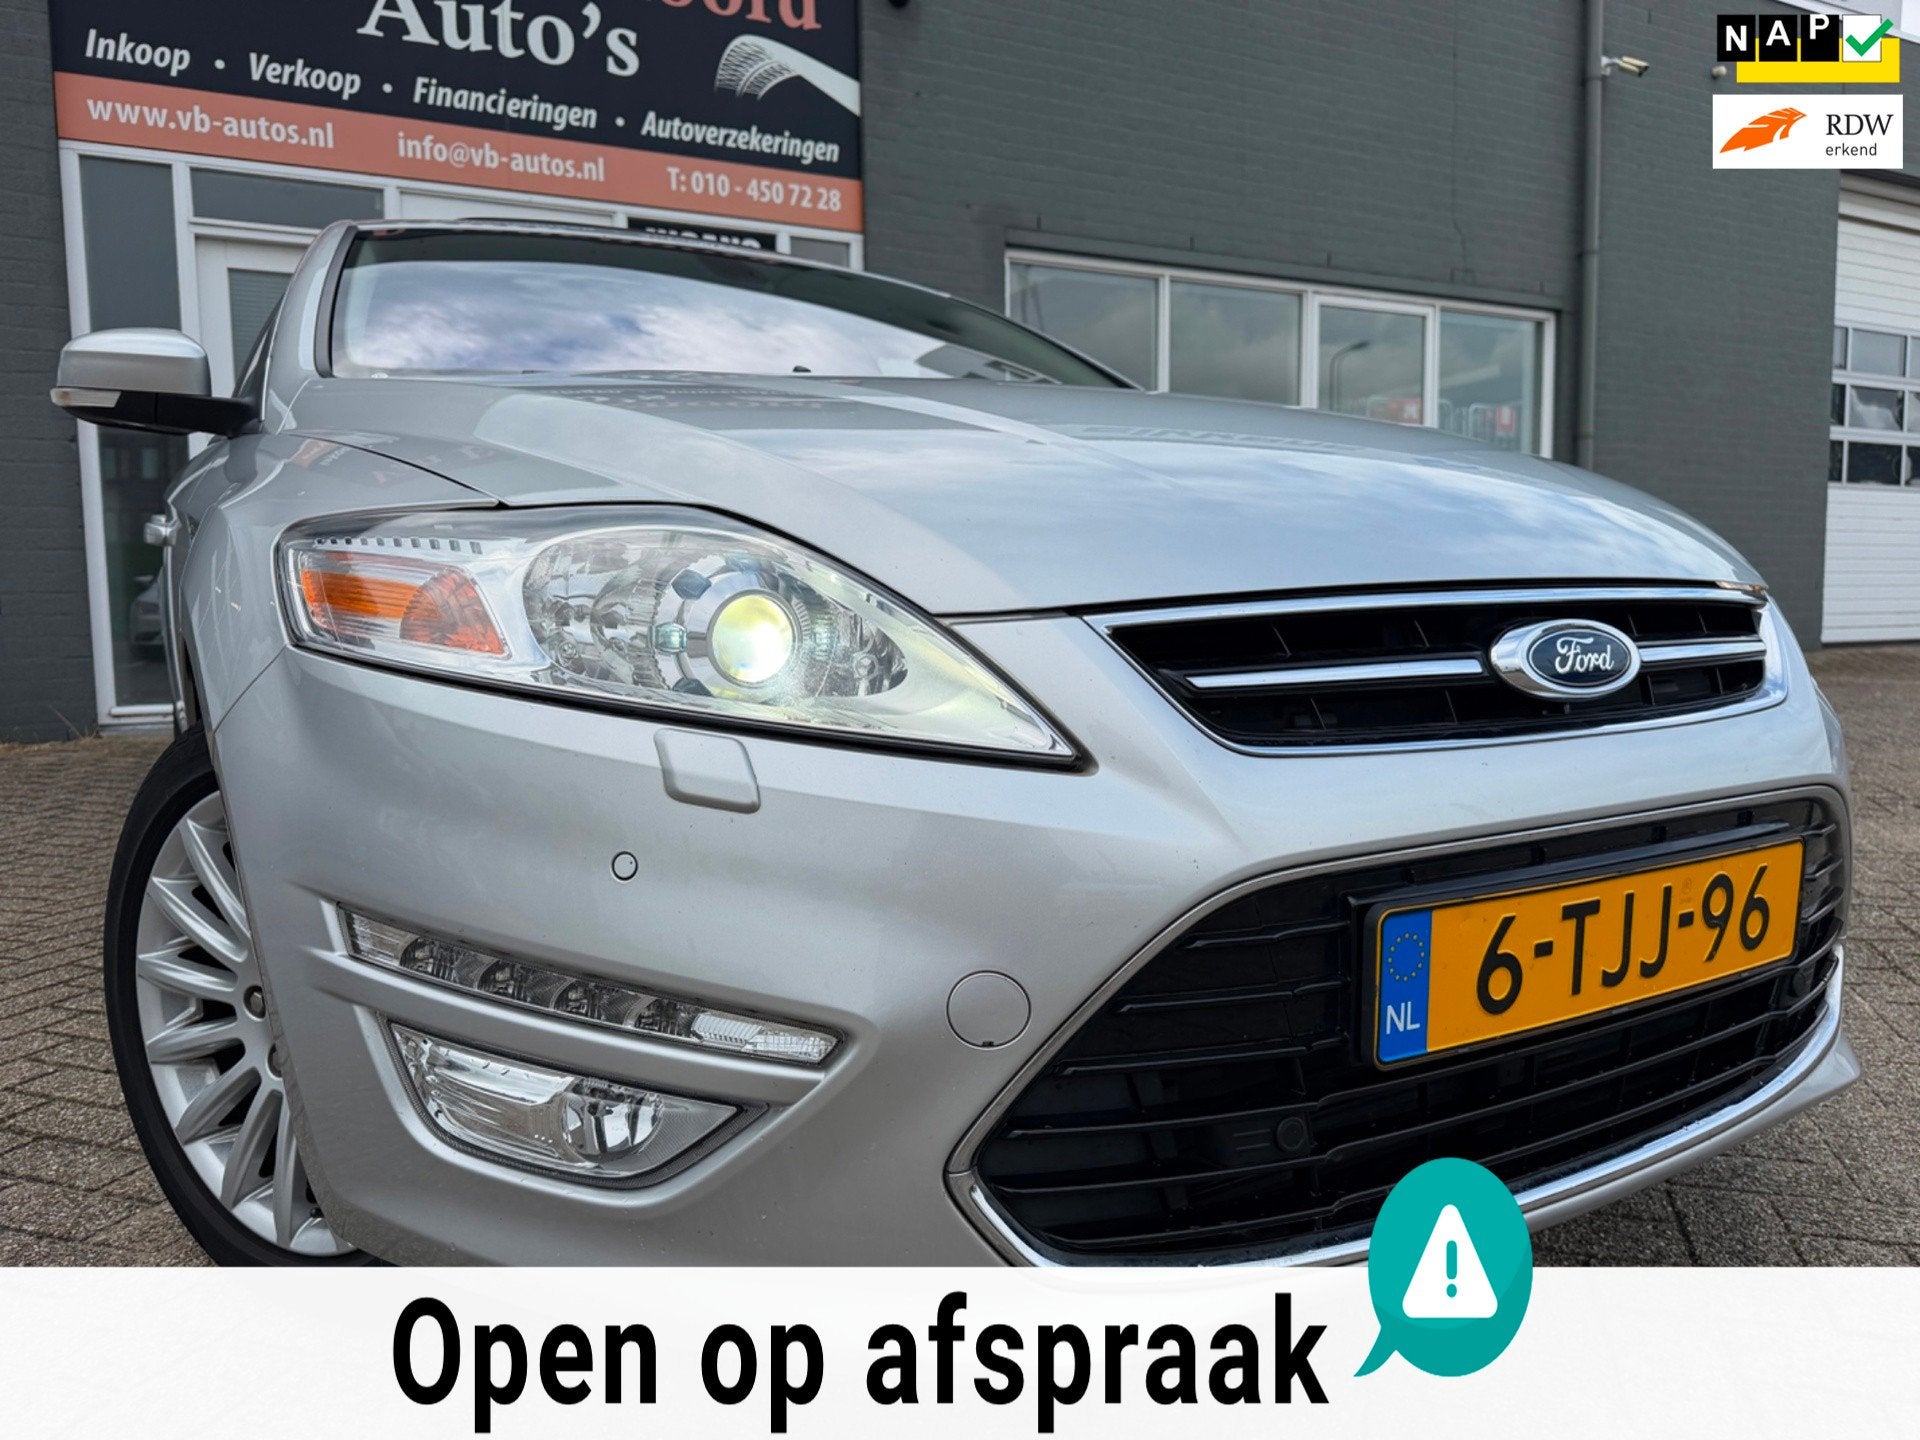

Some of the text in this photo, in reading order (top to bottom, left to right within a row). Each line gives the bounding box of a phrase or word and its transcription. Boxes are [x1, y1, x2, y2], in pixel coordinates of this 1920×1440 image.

[356, 0, 640, 77] Auto's
[85, 28, 840, 165] Inkoop Verkoop Financieringen Autoverzekeringen
[86, 98, 335, 149] www.vb-autos.nl
[397, 132, 605, 182] info@vb-autos.nl
[666, 166, 687, 193] T:
[690, 170, 731, 198] 010
[746, 178, 785, 205] 450
[787, 183, 813, 208] 72
[816, 187, 842, 212] 28
[1555, 636, 1615, 674] Ford
[1476, 865, 1771, 1015] 6-TJJ-96
[1385, 1002, 1421, 1035] NL
